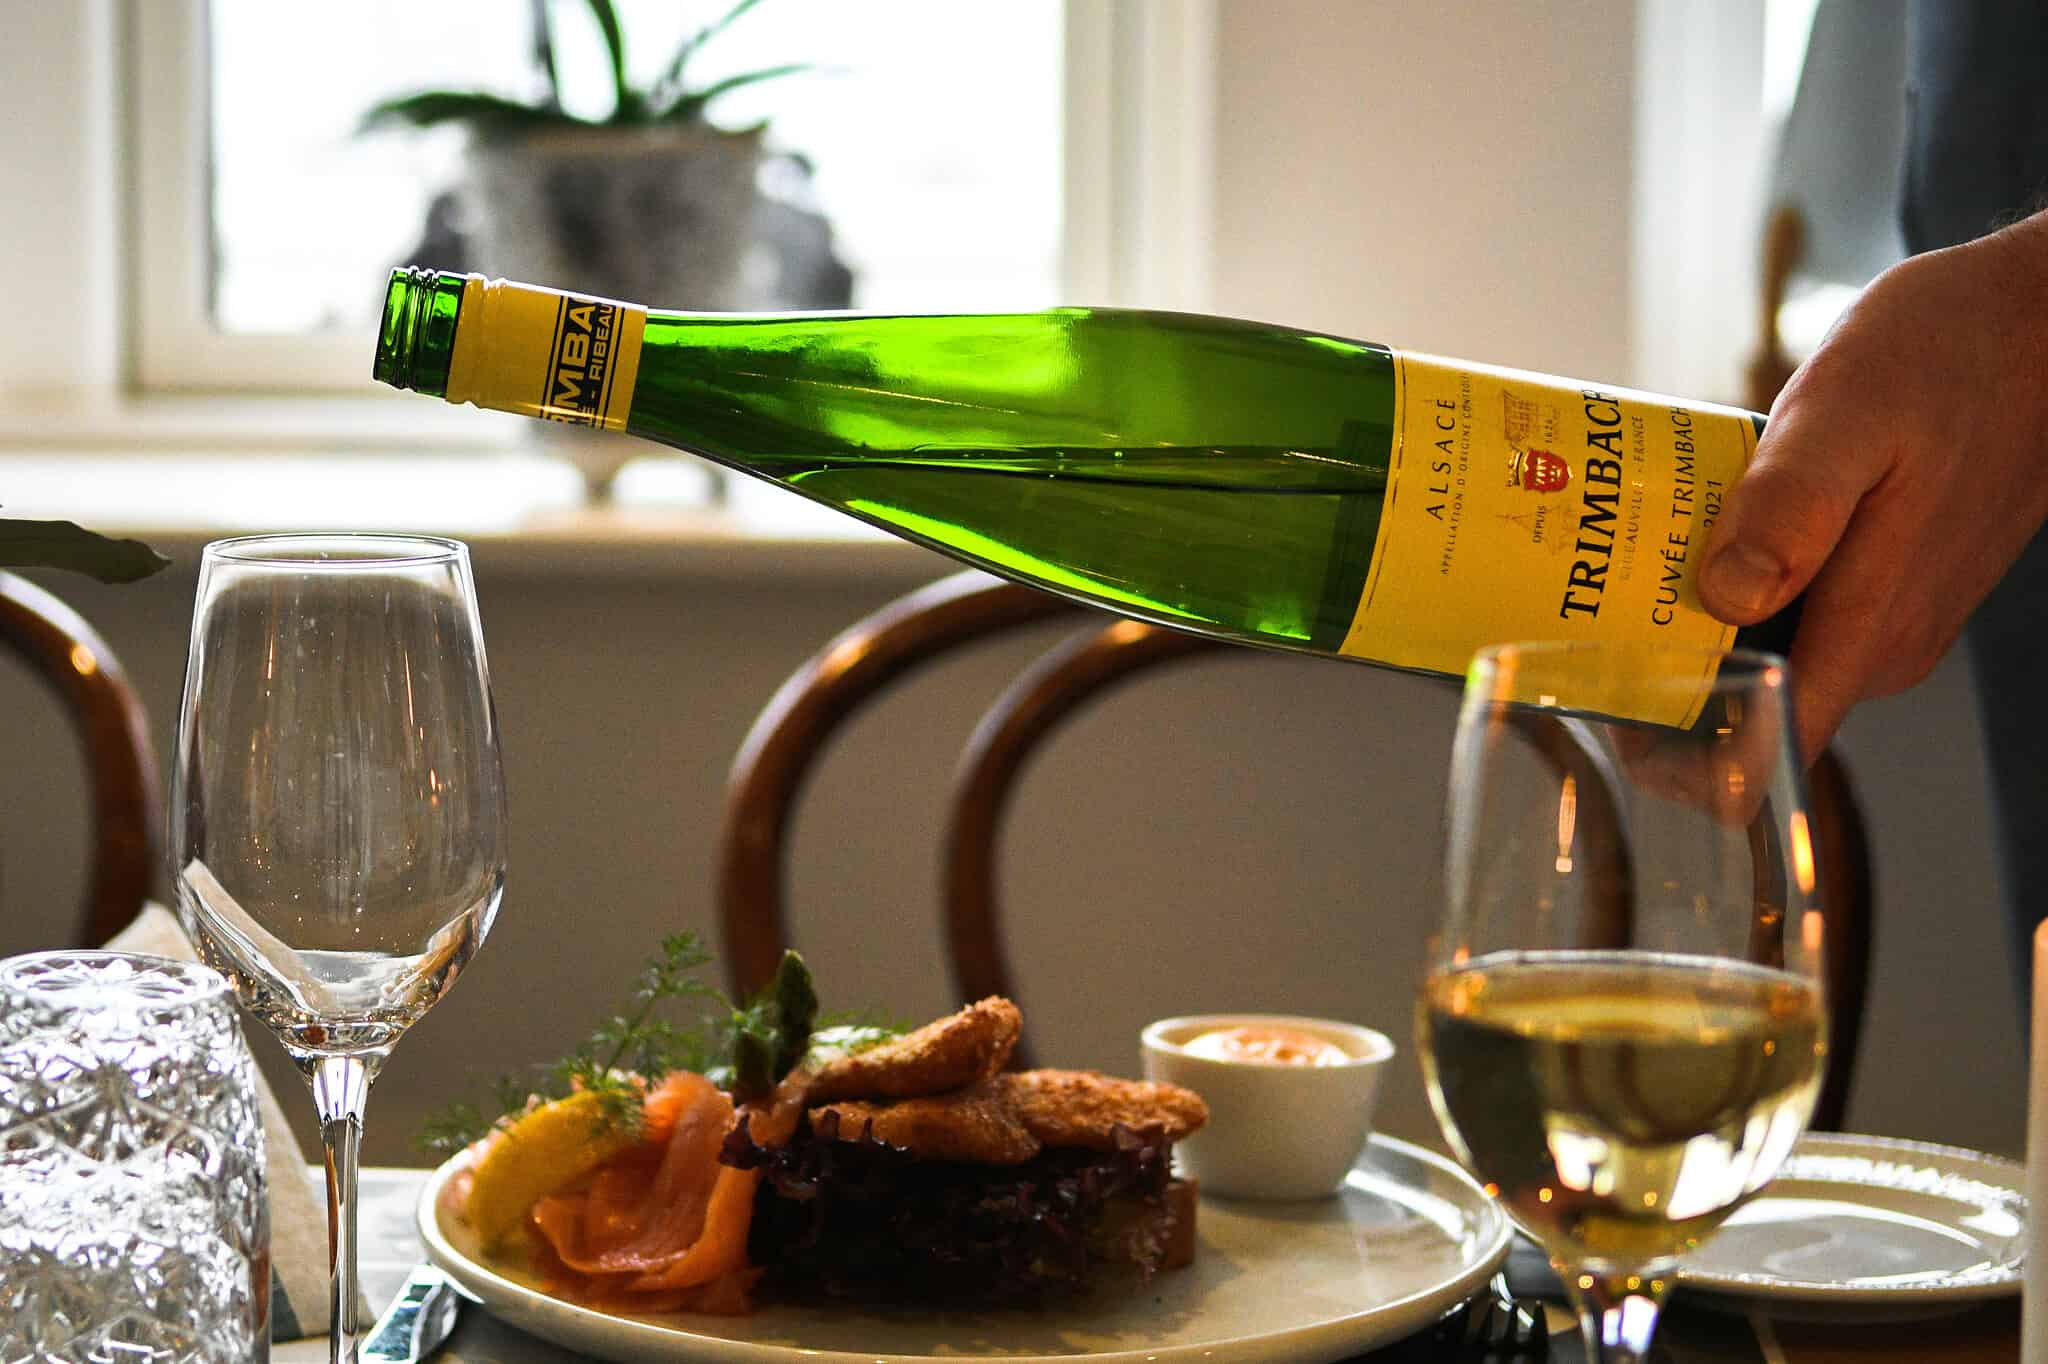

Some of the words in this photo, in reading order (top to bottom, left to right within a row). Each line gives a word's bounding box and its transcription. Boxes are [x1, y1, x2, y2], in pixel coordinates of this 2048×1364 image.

[1425, 399, 1456, 521] ALSACE
[1632, 415, 1645, 463] FRANCE
[1440, 492, 1465, 575] APPELLATION
[1532, 504, 1547, 544] DEPUIS
[1559, 388, 1623, 619] TRIMBACH
[1651, 532, 1689, 626] CUVÉE
[1671, 406, 1697, 518] TRIMBACH
